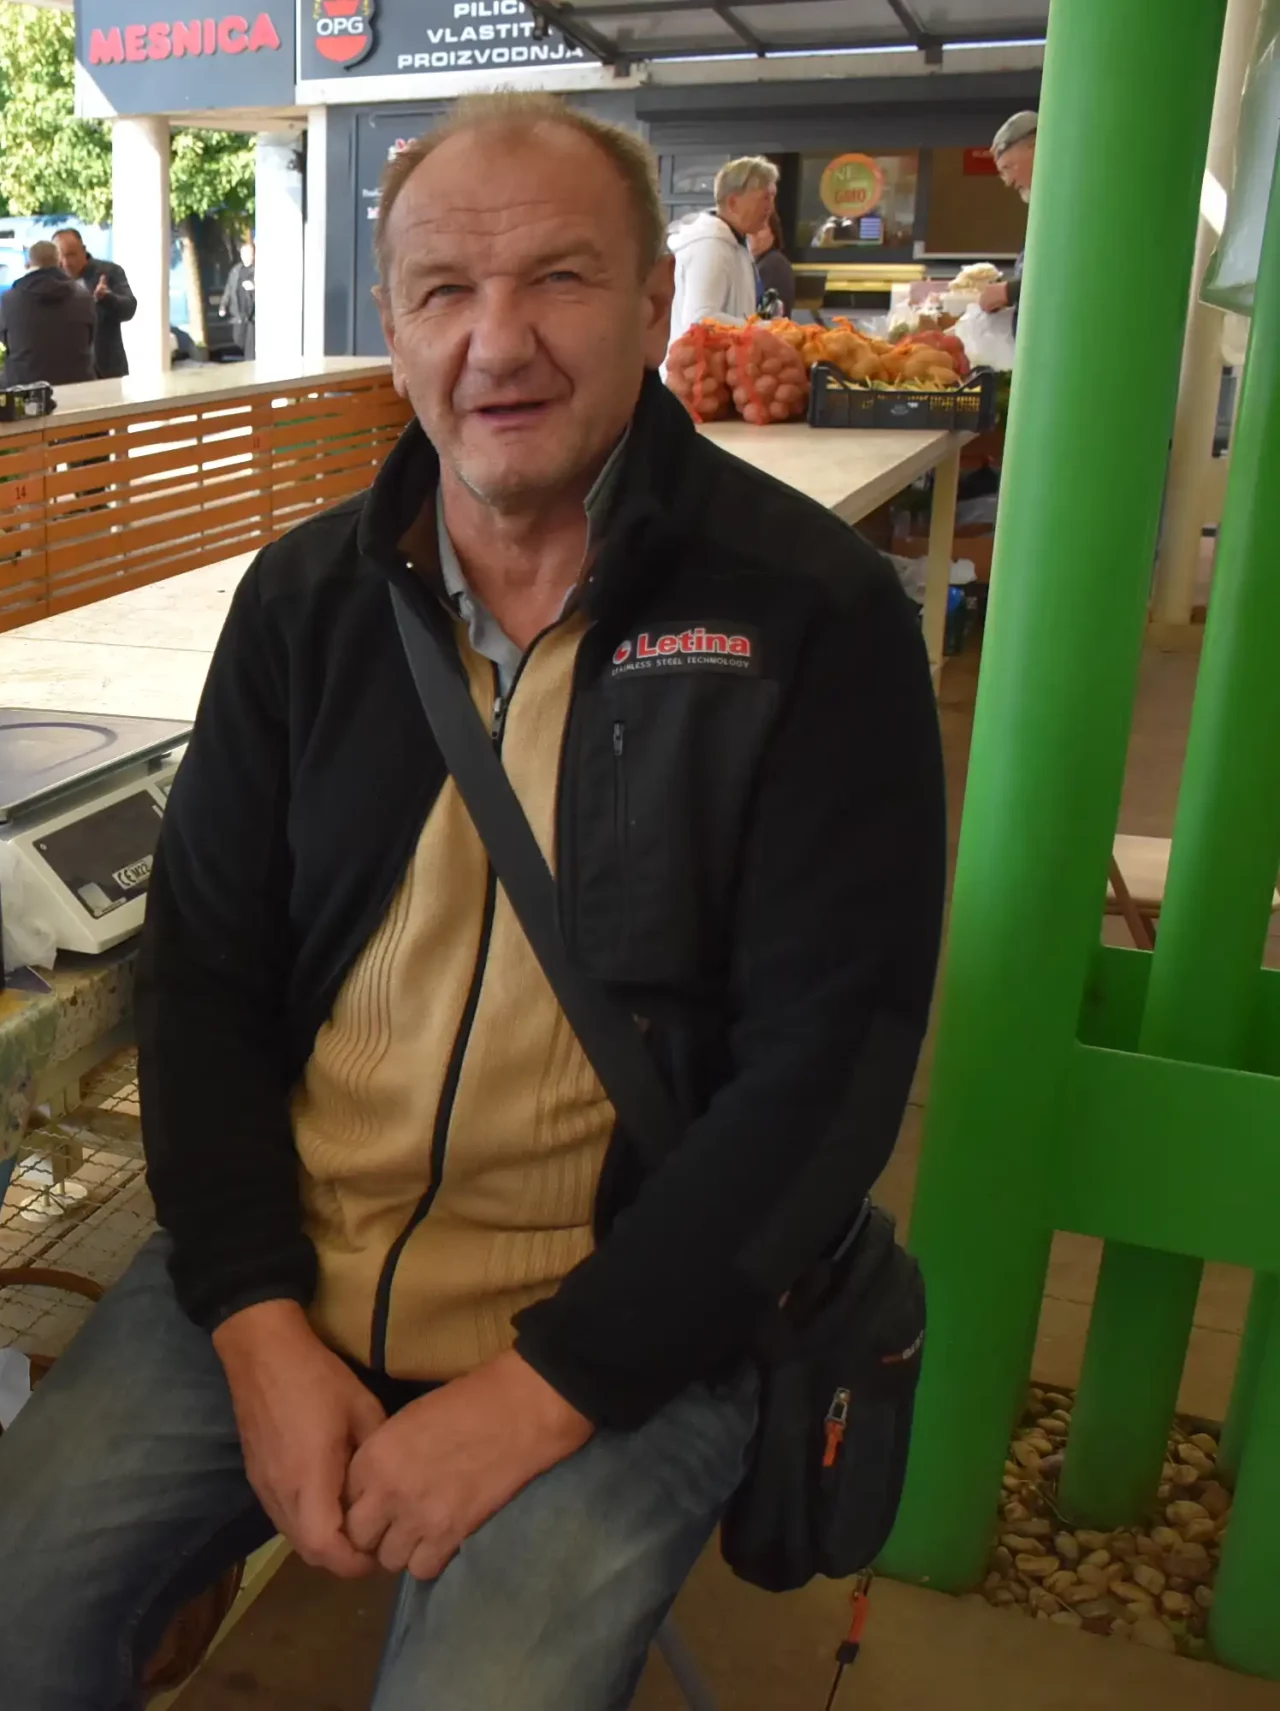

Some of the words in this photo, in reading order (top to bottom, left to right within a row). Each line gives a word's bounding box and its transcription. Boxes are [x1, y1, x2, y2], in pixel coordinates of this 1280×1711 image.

[316, 16, 364, 36] OPG
[427, 21, 553, 44] VLASTIT
[88, 12, 281, 66] MESNICA
[397, 43, 584, 69] PROIZVODNJA
[636, 627, 751, 659] Letina
[656, 657, 683, 667] STEEL
[687, 656, 749, 669] TECHNOLOGY
